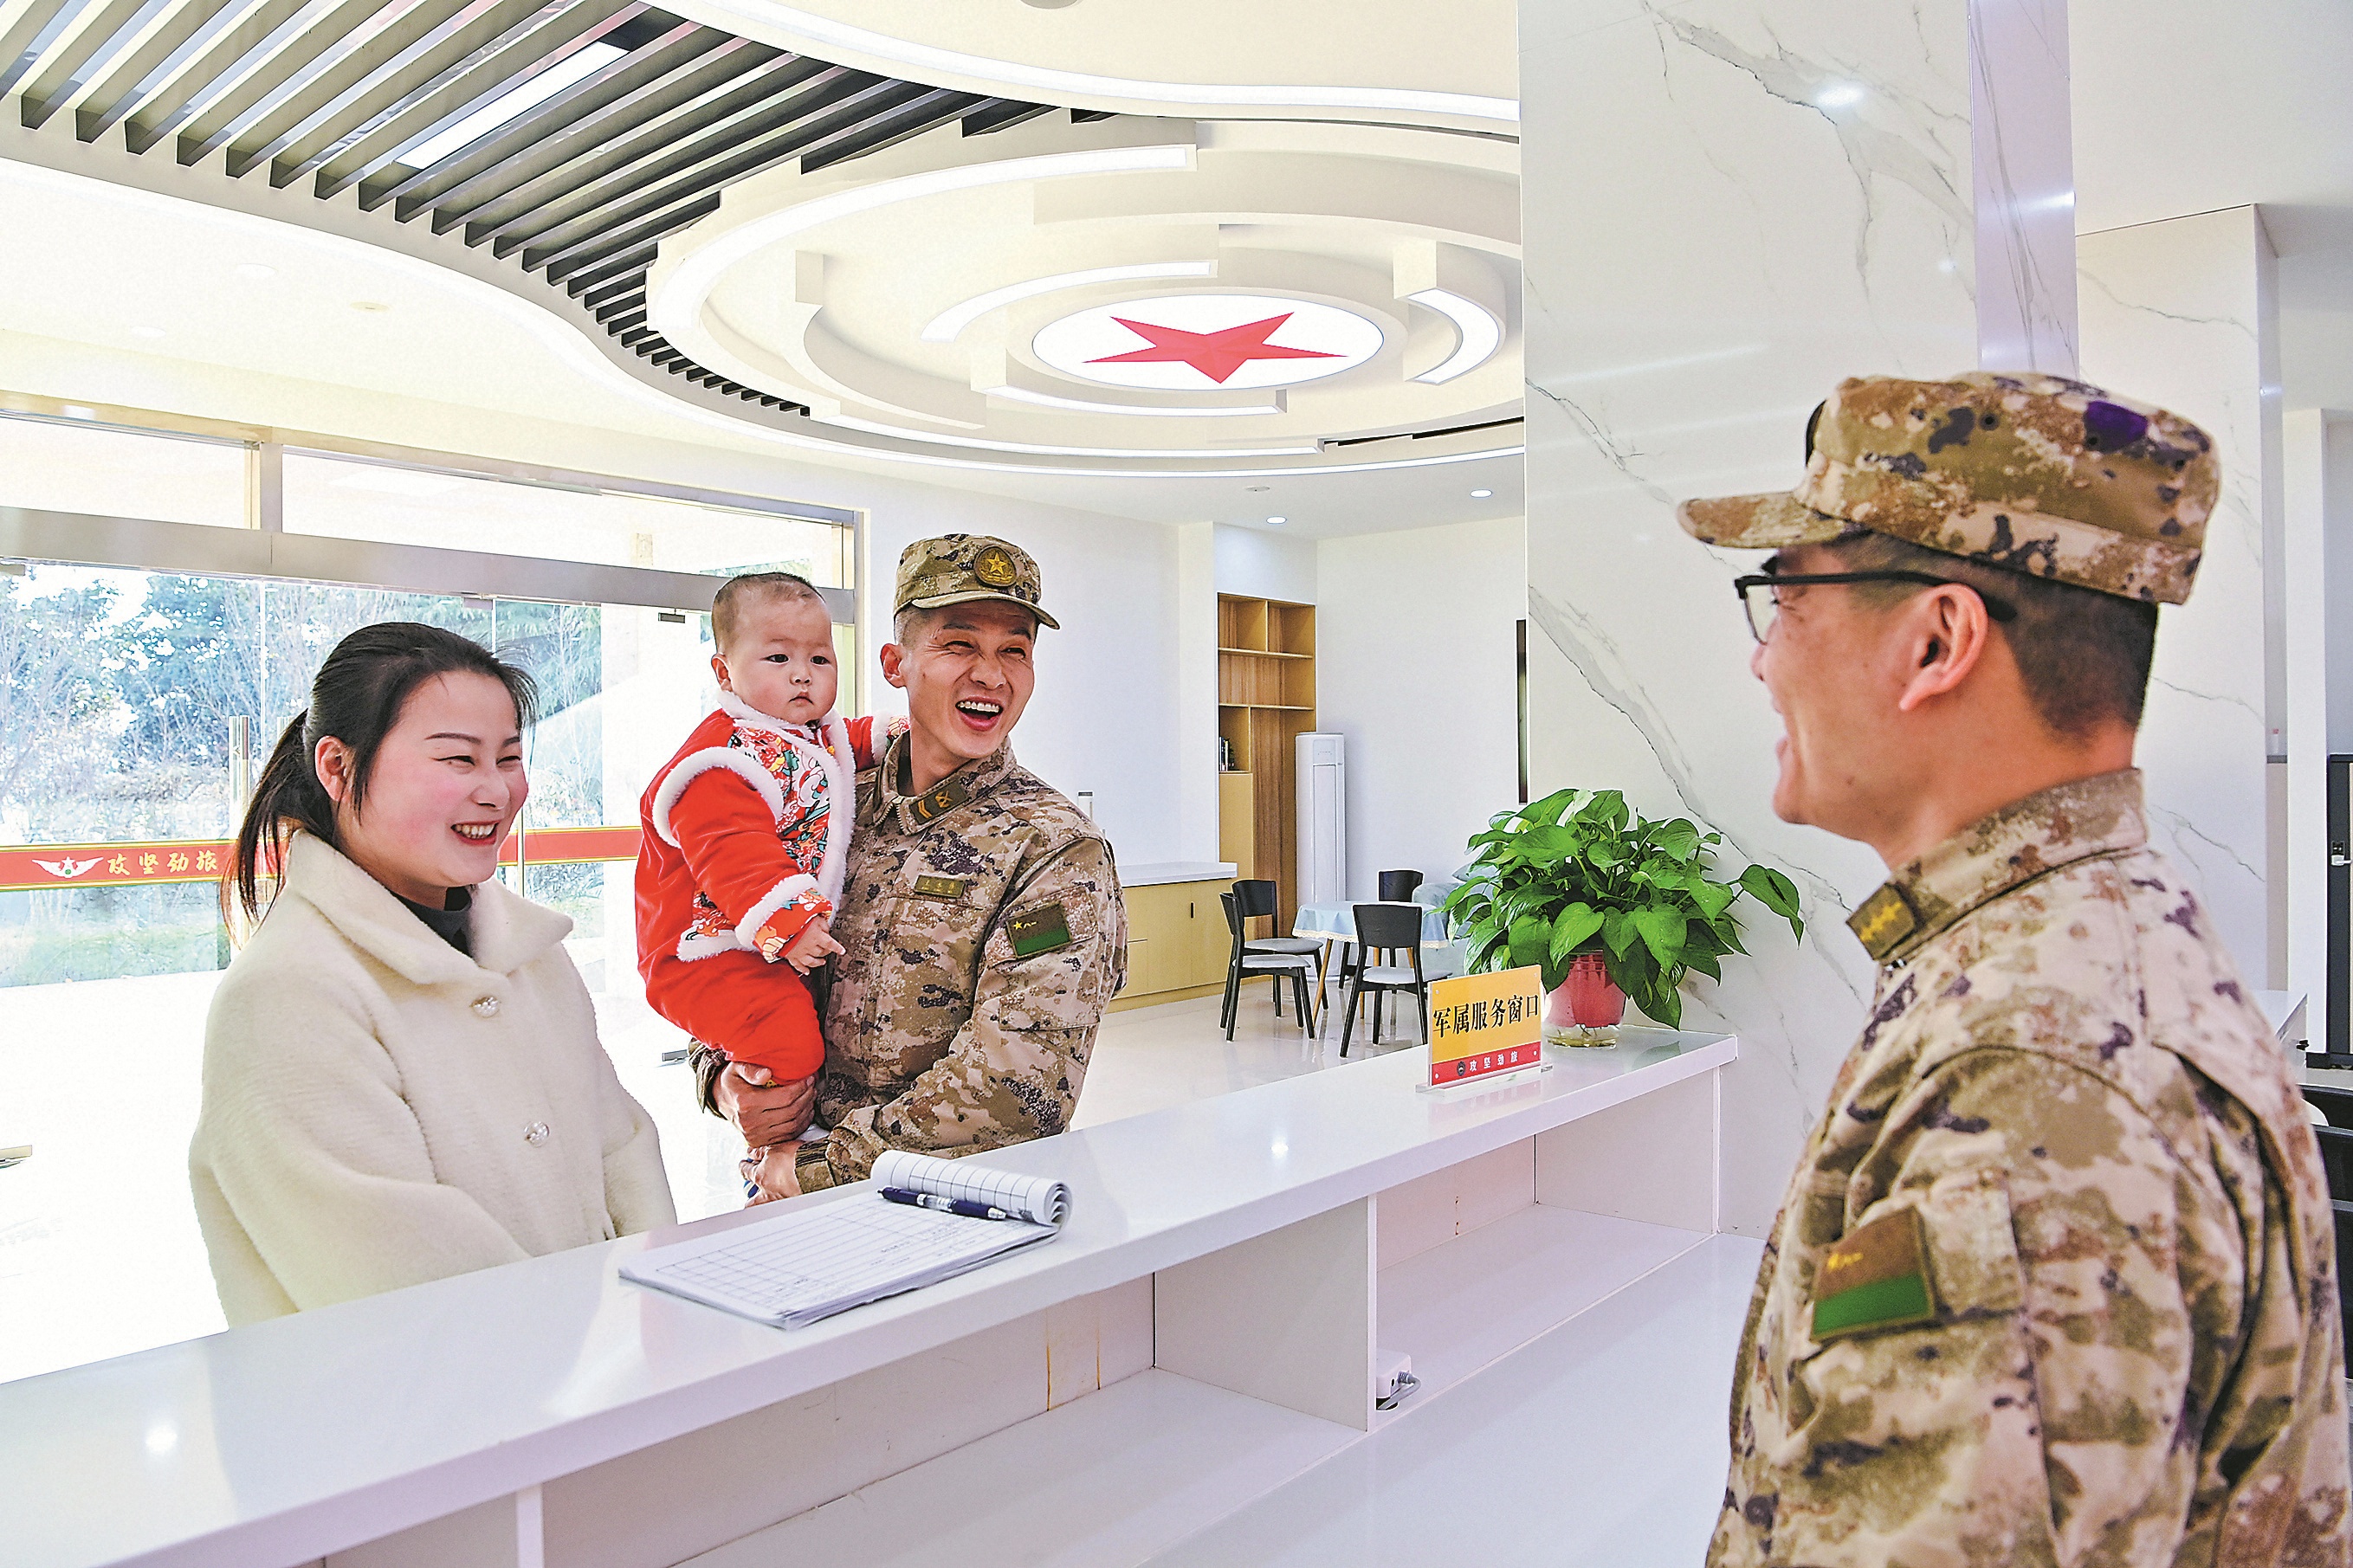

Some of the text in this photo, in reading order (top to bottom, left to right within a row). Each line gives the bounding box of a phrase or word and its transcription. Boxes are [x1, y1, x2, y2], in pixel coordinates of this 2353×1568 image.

[107, 850, 217, 875] 攻坚劲旅
[1433, 995, 1538, 1037] 军属服务窗口
[1469, 1050, 1518, 1071] 攻坚劲旅
